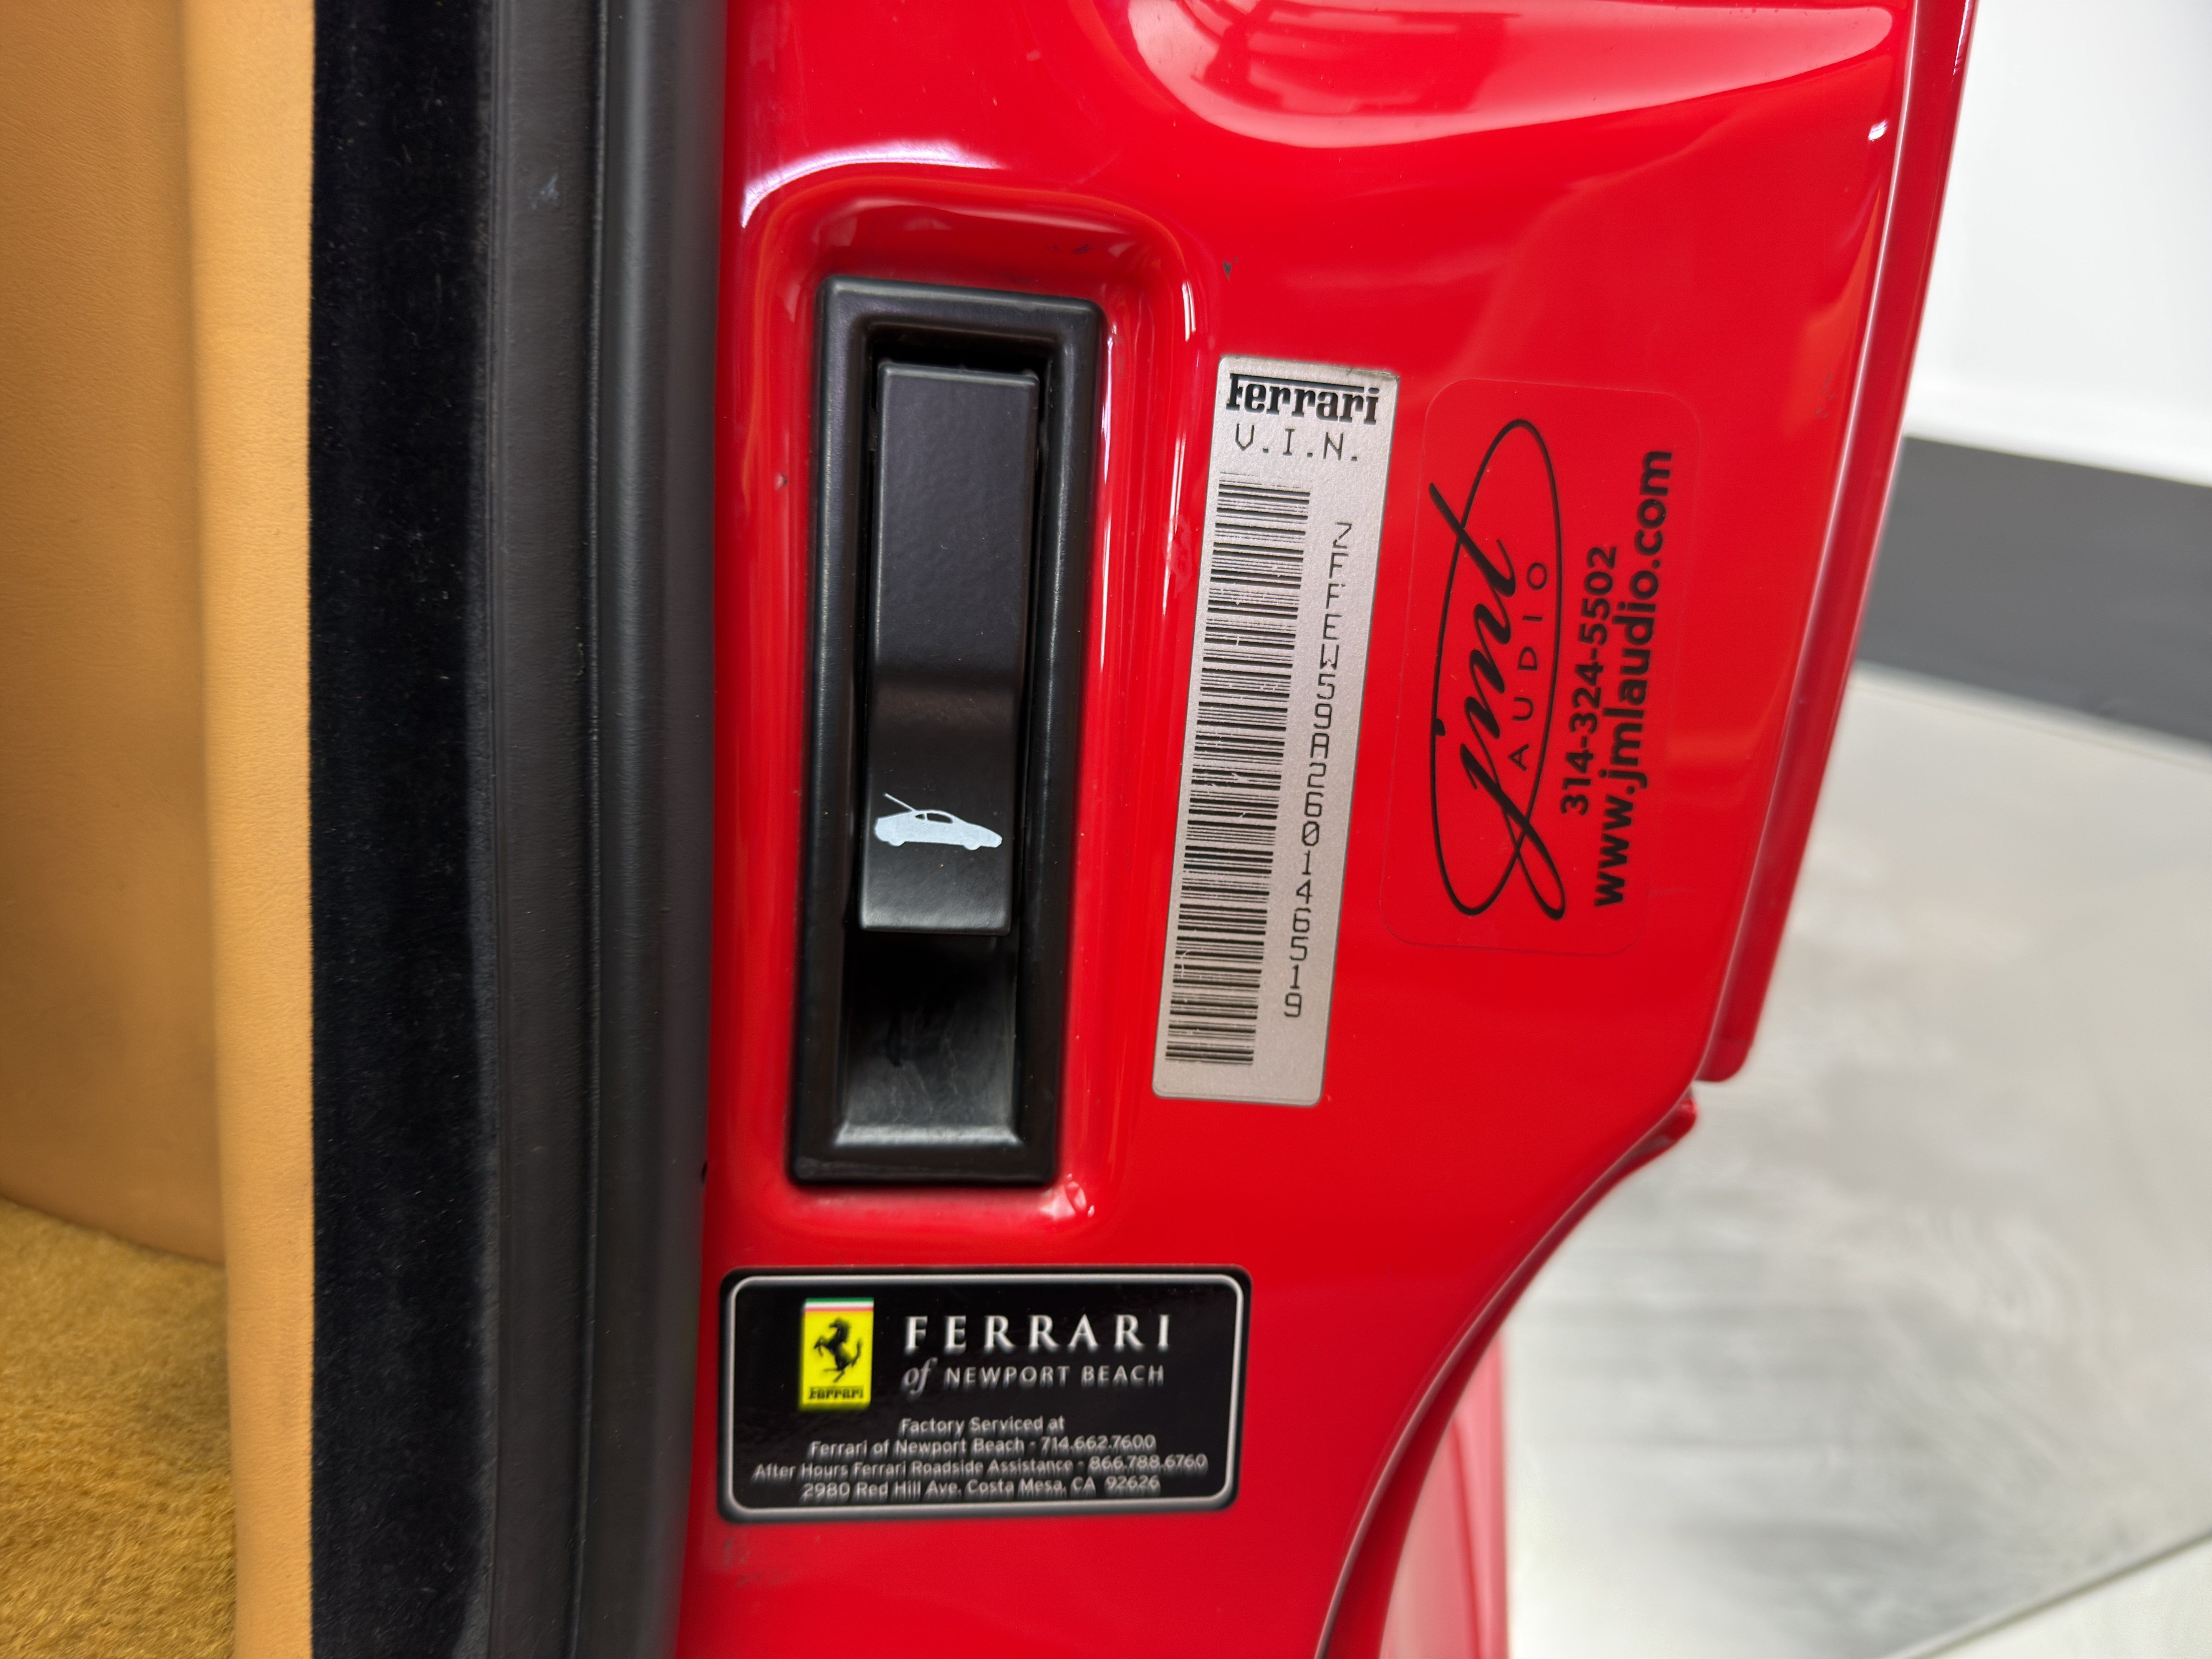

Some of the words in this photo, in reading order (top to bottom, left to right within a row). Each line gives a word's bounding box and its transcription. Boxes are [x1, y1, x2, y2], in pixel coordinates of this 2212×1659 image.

[1227, 373, 1379, 425] Ferrari
[1235, 423, 1358, 461] V.I.N.
[1560, 545, 1618, 816] 314-324-5502
[1594, 450, 1671, 907] www.jmlaudio.com
[904, 1313, 1170, 1351] FERRARI
[904, 1358, 937, 1395] of
[946, 1366, 1070, 1384] NEWPORT
[1081, 1365, 1164, 1382] BEACH
[901, 1418, 965, 1435] Factory
[970, 1416, 1043, 1432] Serviced
[1048, 1415, 1065, 1432] at
[811, 1439, 868, 1456] Ferrari
[872, 1439, 890, 1455] of
[894, 1438, 967, 1457] Newport
[973, 1437, 1024, 1454] Beach
[1040, 1434, 1157, 1453] 714.662.7600
[755, 1463, 796, 1479] After
[801, 1463, 848, 1479] Hours
[853, 1460, 906, 1477] Ferrari
[912, 1459, 984, 1475] Roadside
[987, 1458, 1073, 1475] Assistance
[1089, 1453, 1209, 1472] 866.788.6760
[803, 1482, 850, 1498] 2980
[856, 1481, 888, 1497] Red
[894, 1480, 921, 1497] Hill
[967, 1479, 1015, 1495] Costa
[1071, 1476, 1096, 1493] CA
[1104, 1475, 1161, 1492] 92626
